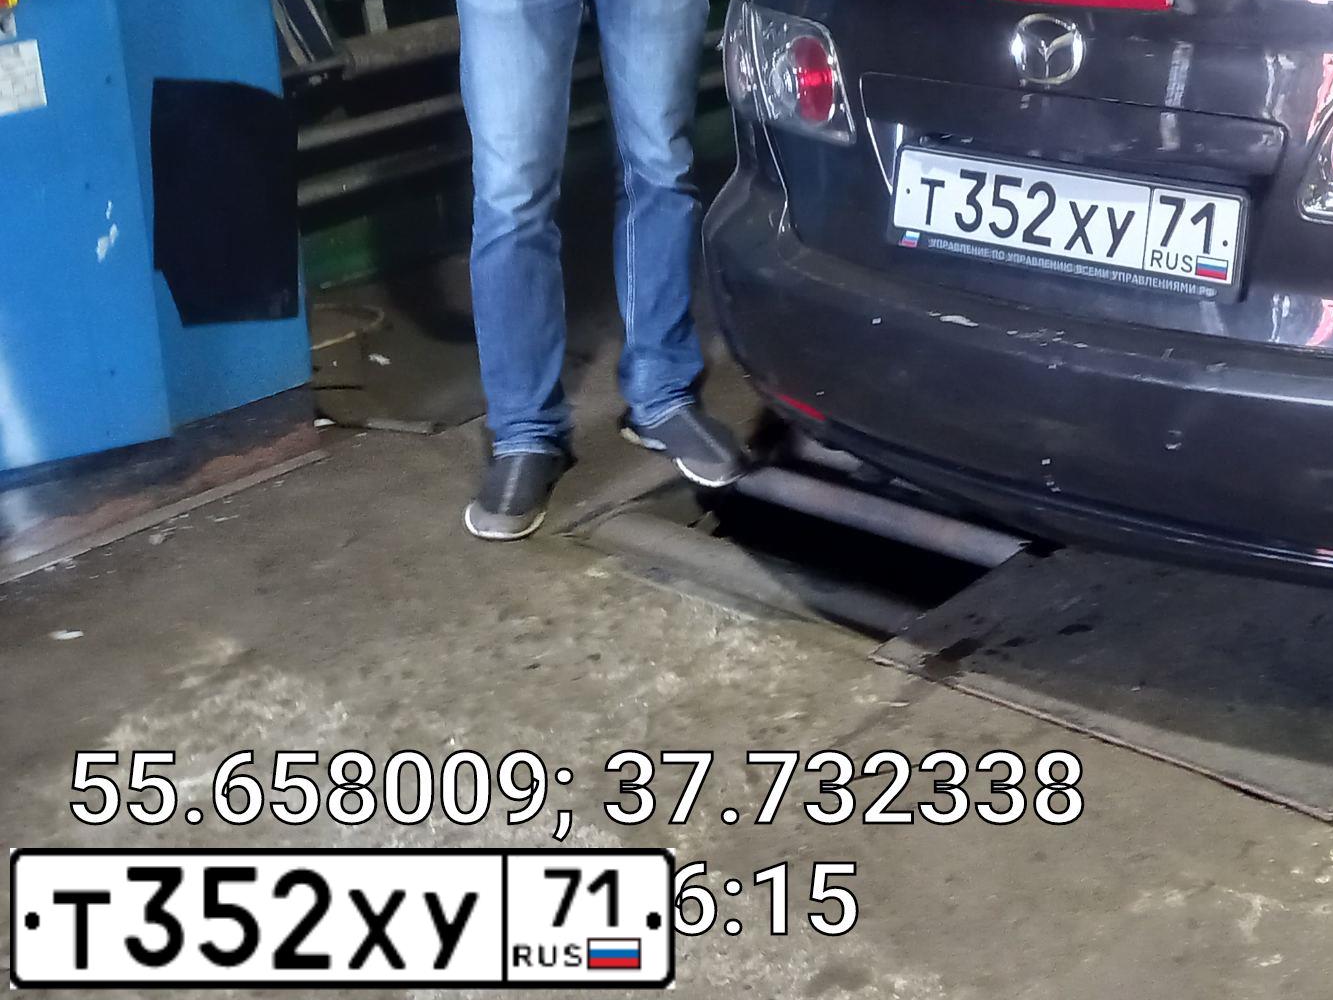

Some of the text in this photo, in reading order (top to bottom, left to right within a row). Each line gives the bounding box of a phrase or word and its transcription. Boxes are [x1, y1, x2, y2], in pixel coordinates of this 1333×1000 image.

[919, 168, 1216, 258] Т352ХУ 71
[928, 238, 990, 258] УПРАВЛЕНИЕ
[992, 249, 1006, 261] ПО
[1006, 252, 1074, 273] УПРАВЛЕНИЮ
[1075, 263, 1110, 279] ВСЕМИ
[1111, 270, 1197, 294] УПРАВЛЕНИЯМИ
[1150, 250, 1193, 273] RUS
